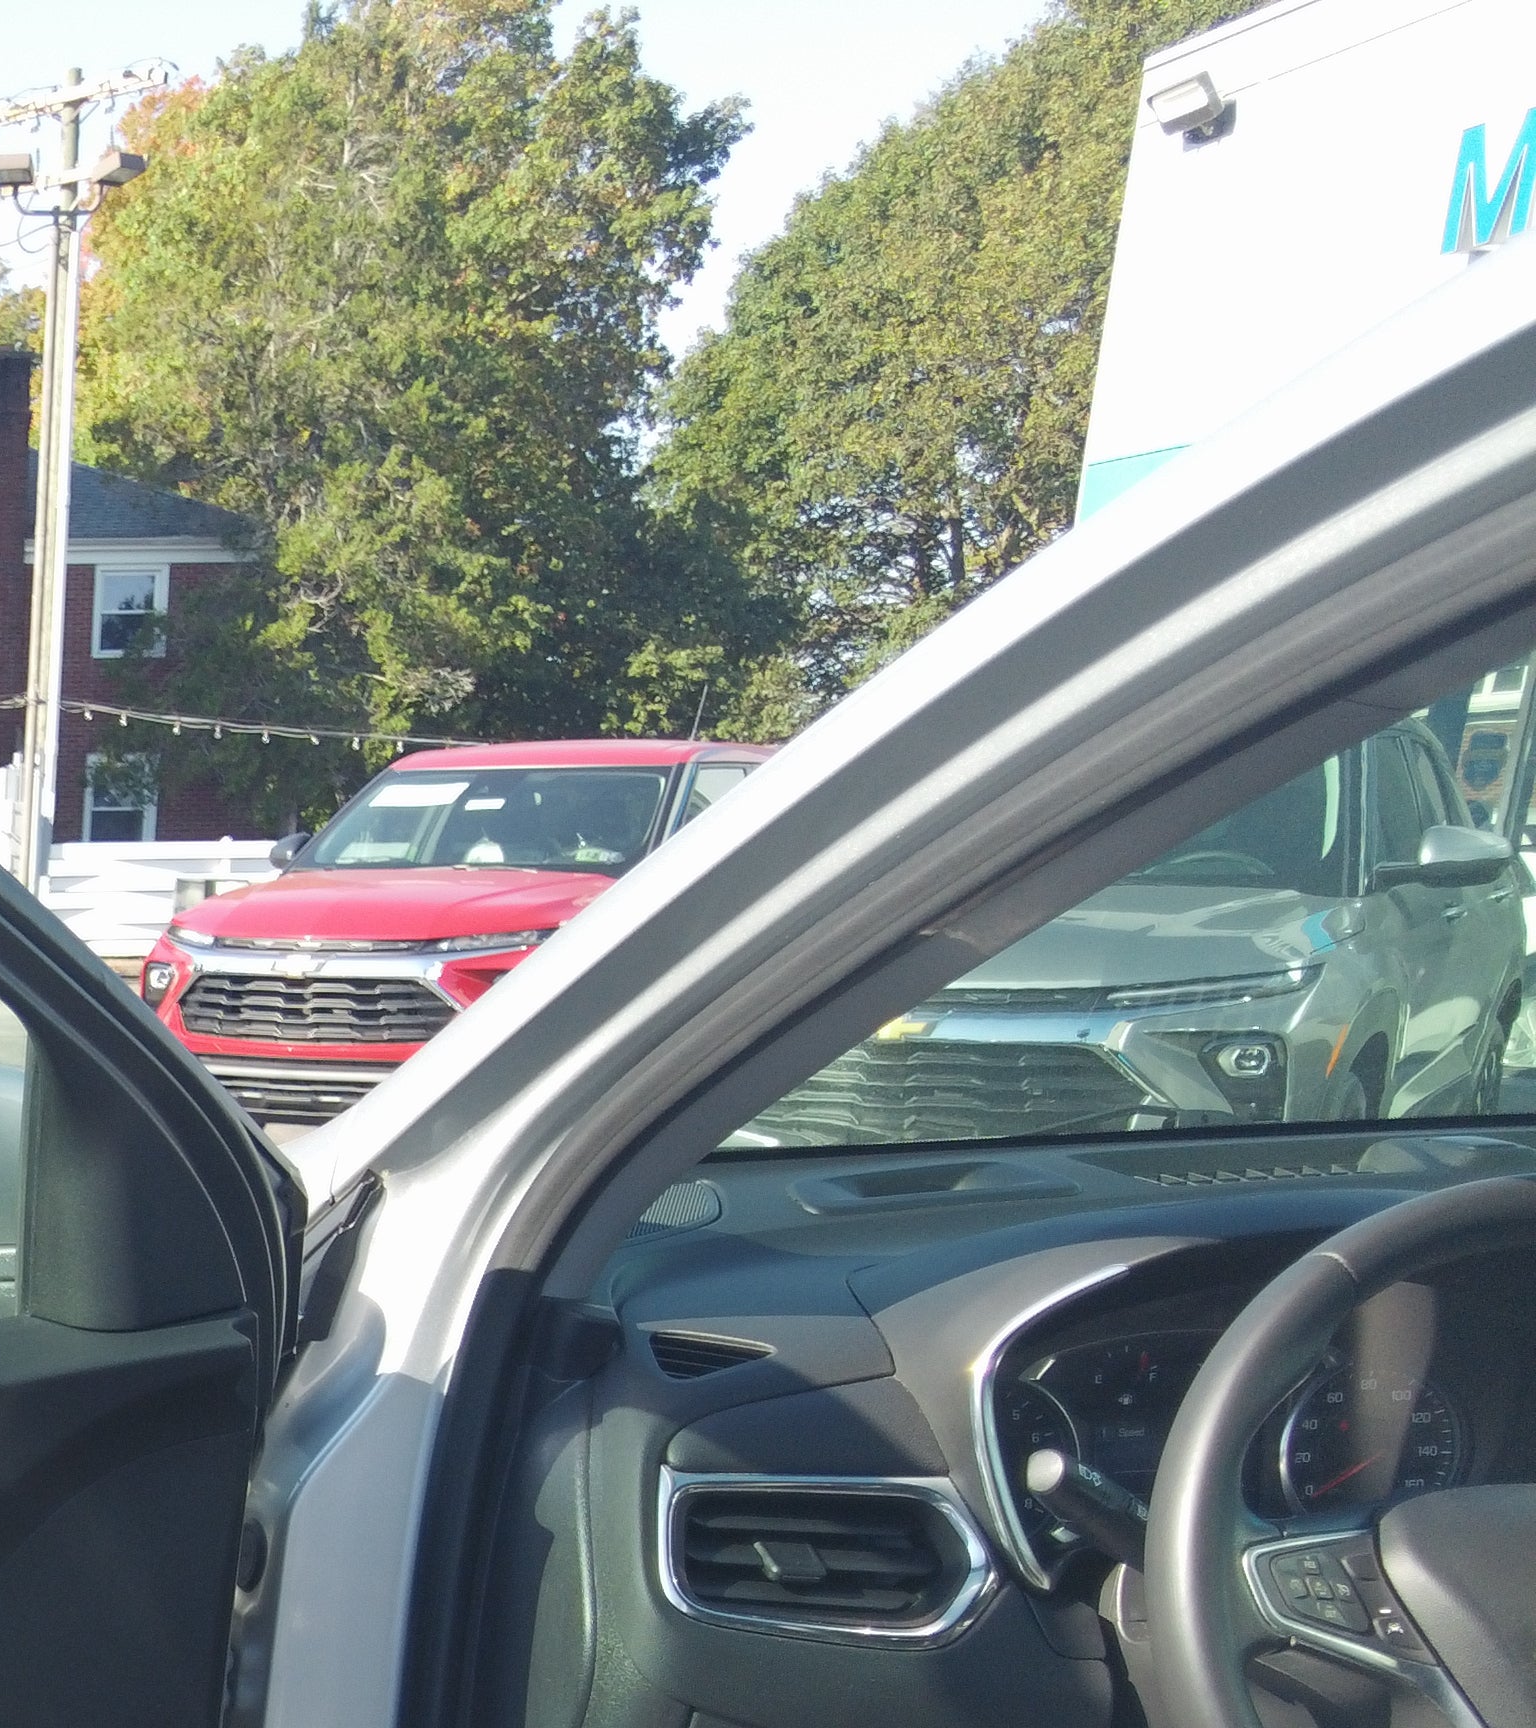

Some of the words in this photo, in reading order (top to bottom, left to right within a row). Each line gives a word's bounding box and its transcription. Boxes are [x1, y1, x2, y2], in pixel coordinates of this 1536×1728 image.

[1149, 1372, 1157, 1382] F
[1360, 1378, 1377, 1390] 80
[1328, 1392, 1343, 1403] 60
[1392, 1390, 1412, 1402] 100
[1012, 1410, 1020, 1420] 5
[1411, 1412, 1431, 1424] 120
[1302, 1419, 1318, 1430] 40
[1032, 1432, 1040, 1443] 6
[1417, 1445, 1438, 1457] 140
[1295, 1452, 1311, 1463] 20
[1305, 1485, 1313, 1496] 0
